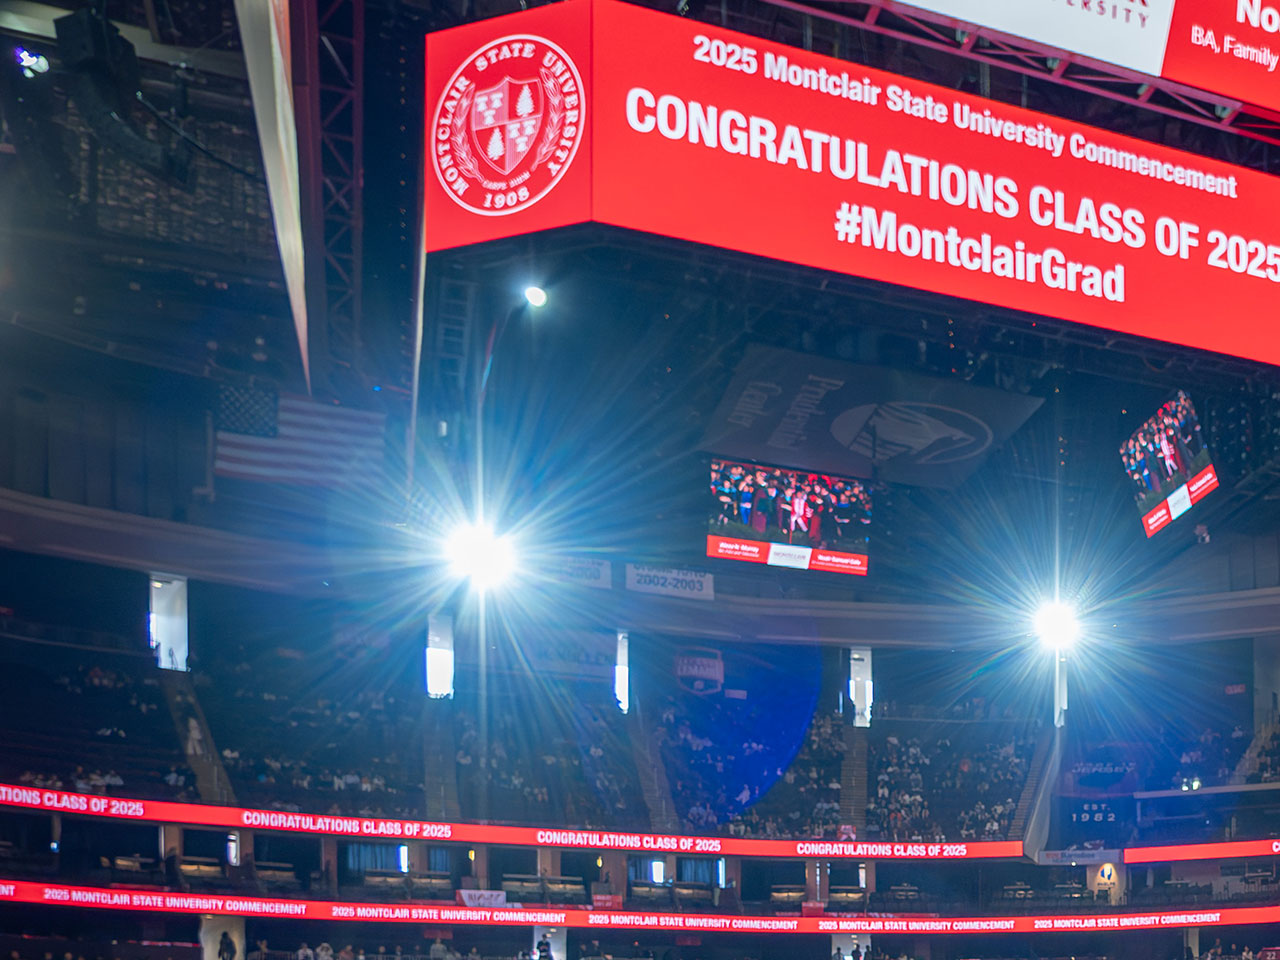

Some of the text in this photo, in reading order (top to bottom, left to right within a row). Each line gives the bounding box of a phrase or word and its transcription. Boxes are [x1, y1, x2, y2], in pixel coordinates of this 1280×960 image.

[1192, 25, 1220, 53] BA,
[1224, 35, 1279, 71] Family
[437, 42, 579, 197] MONTCLAIR STATE UNIVERSITY
[694, 35, 1237, 198] 2025 Montclair State University Commencement
[626, 88, 1019, 218] CONGRATULATIONS
[1030, 186, 1145, 248] CLASS
[1155, 217, 1199, 259] OF
[483, 186, 531, 209] 1908
[835, 202, 1124, 302] #MontclairGrad
[635, 573, 704, 592] 2002-2003
[43, 792, 87, 810] CLASS
[90, 798, 107, 812] OF
[110, 800, 143, 816] 2025
[243, 811, 451, 837] CONGRATULATIONS CLASS OF 2025
[1071, 813, 1116, 822] 1982
[537, 831, 720, 851] CONGRATULATIONS CLASS OF 2025
[797, 843, 967, 856] CONGRATULATIONS CLASS OF 2025
[44, 888, 306, 914] 2025 MONTCLAIR STATE UNIVERSITY COMMENCEMENT
[333, 907, 565, 922] 2025 MONTCLAIR STATE UNIVERSITY COMMENCEMENT
[589, 914, 797, 929] 2025 MONTCLAIR STATE UNIVERSITY COMMENCEMENT
[819, 920, 1014, 930] 2025 MONTCLAIR STATE UNIVERSITY COMMENCEMENT
[1035, 913, 1220, 928] 2025 MONTCLAIR STATE UNIVERSITY COMMENCEMENT
[1266, 952, 1277, 960] 22
